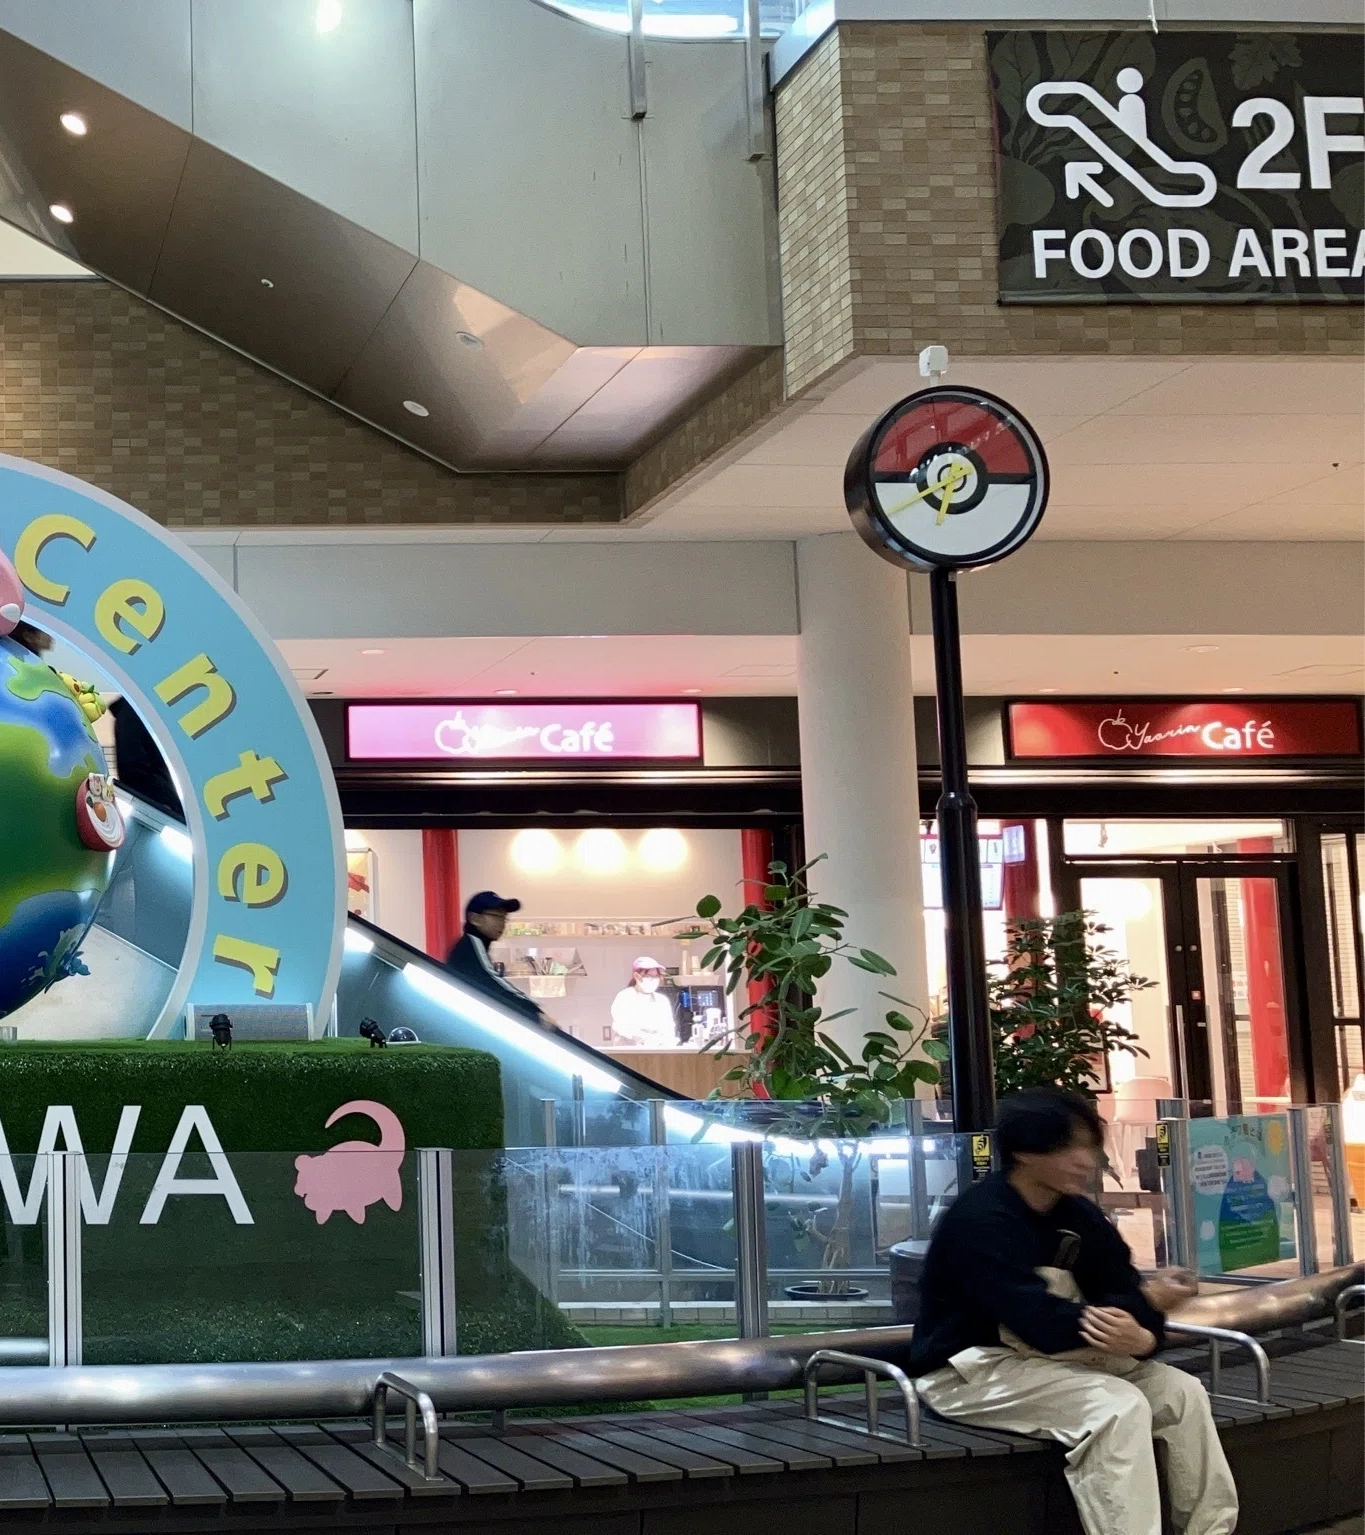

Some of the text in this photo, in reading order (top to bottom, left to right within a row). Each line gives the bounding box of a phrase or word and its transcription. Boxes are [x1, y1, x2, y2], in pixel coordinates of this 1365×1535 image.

[1232, 97, 1365, 189] 2F
[1032, 228, 1210, 279] FOOD
[16, 514, 287, 998] Center
[539, 721, 615, 753] Café
[1201, 720, 1275, 751] Café
